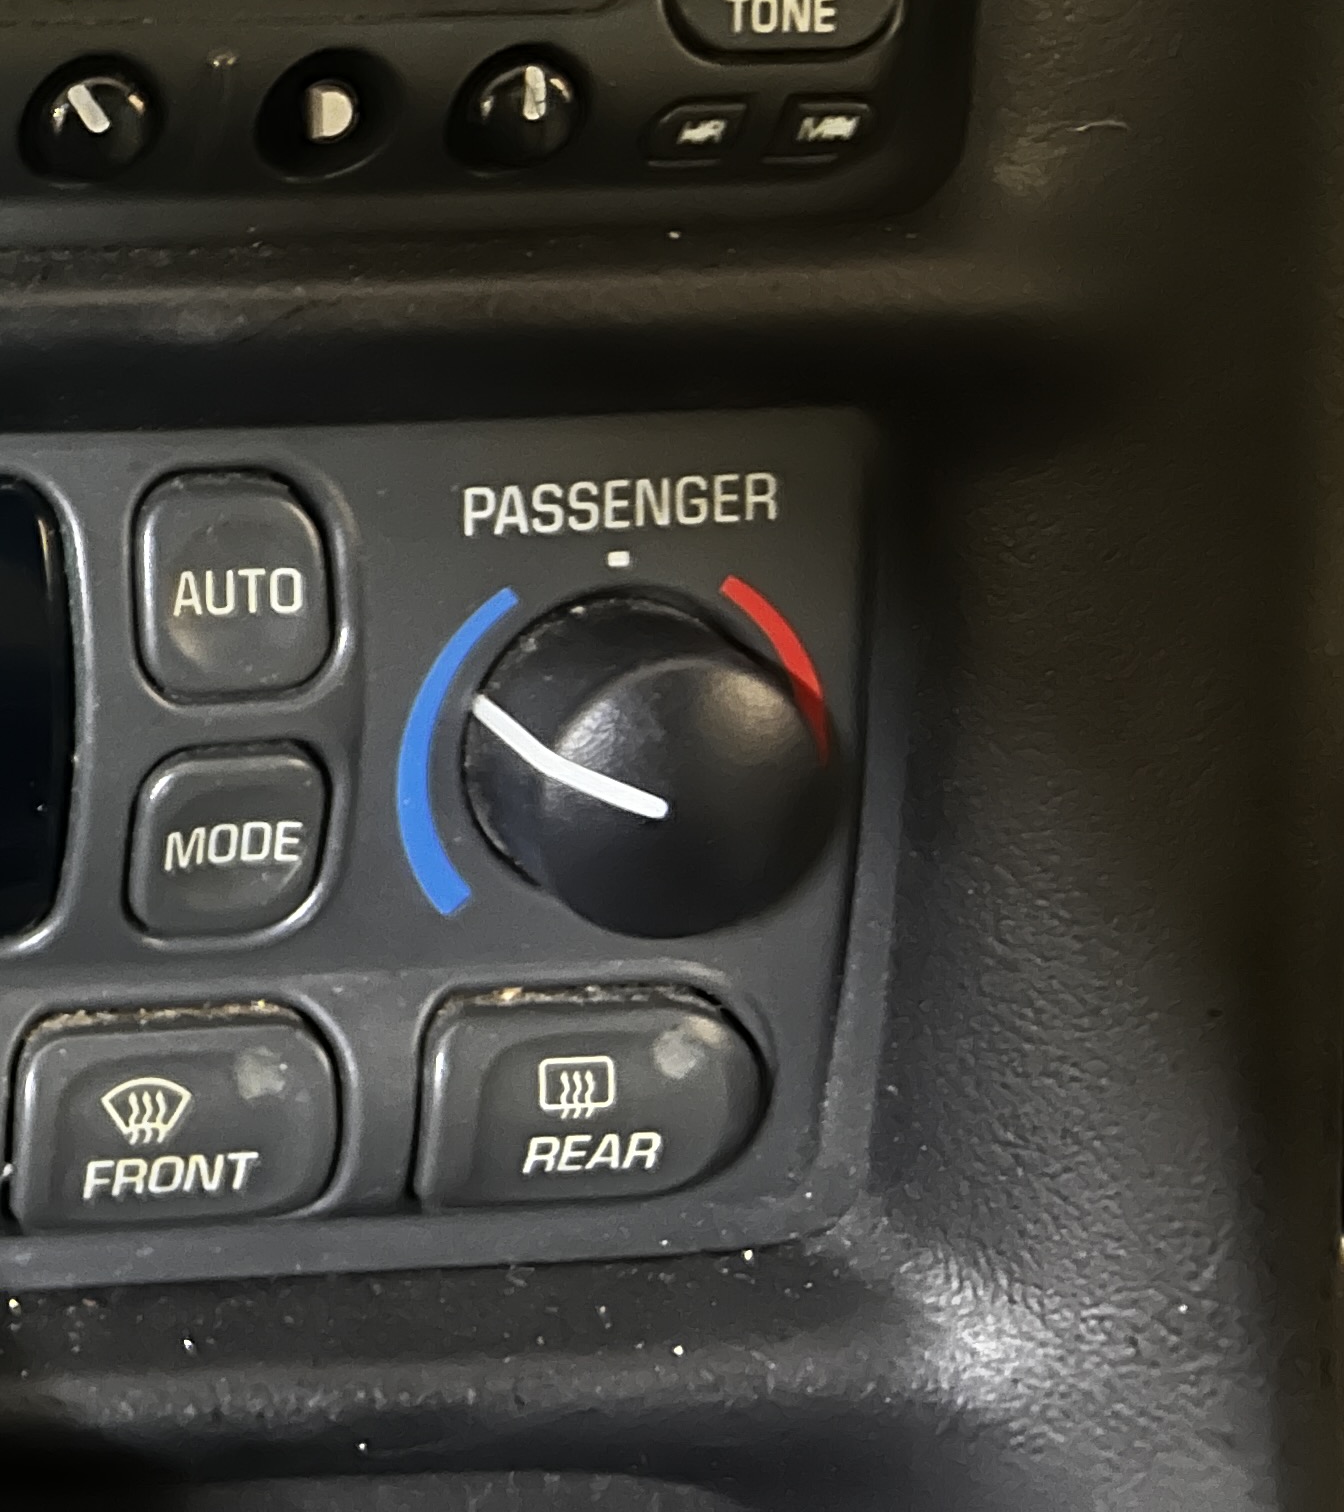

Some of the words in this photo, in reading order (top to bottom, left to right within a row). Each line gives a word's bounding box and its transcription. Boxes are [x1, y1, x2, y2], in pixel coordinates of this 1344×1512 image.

[462, 472, 779, 538] PASSENGER
[172, 567, 303, 616] AUTO
[164, 821, 302, 872] MODE
[82, 1151, 259, 1199] FRONT
[522, 1132, 661, 1176] REAR
